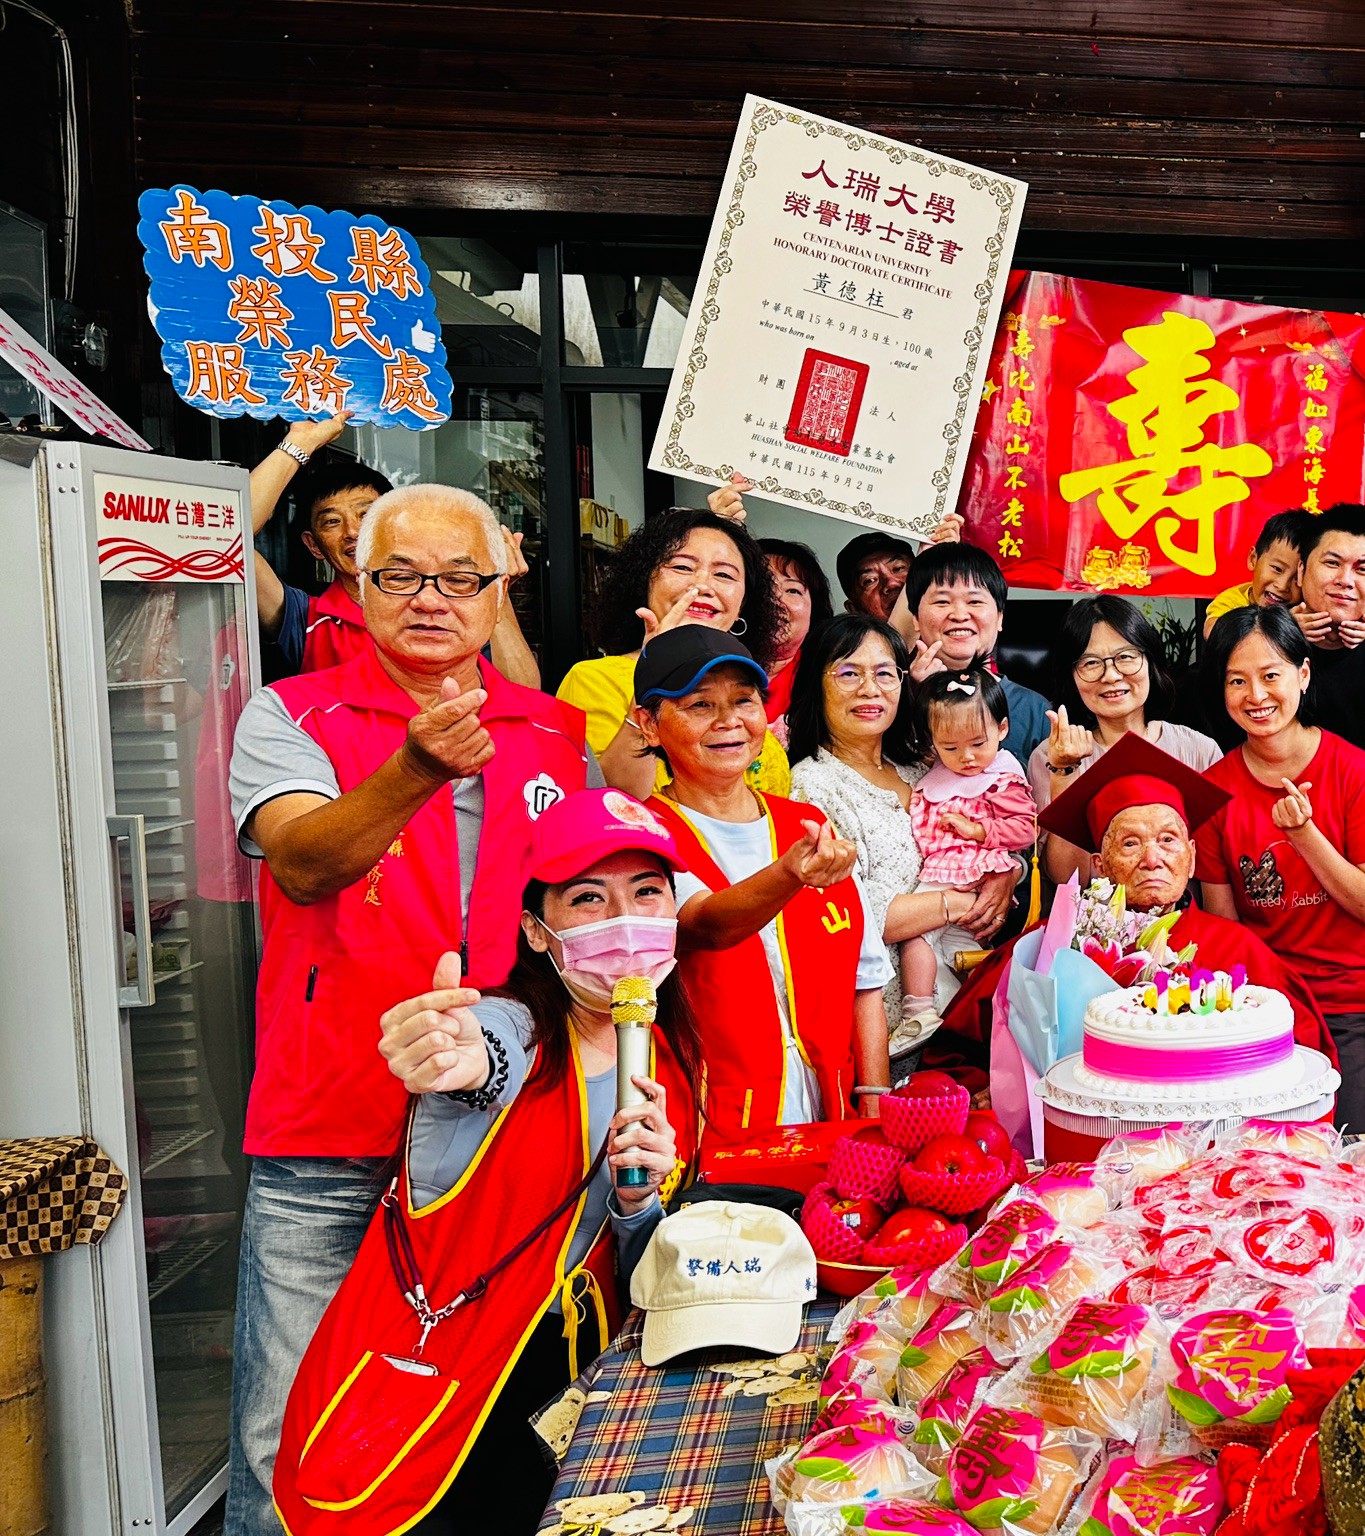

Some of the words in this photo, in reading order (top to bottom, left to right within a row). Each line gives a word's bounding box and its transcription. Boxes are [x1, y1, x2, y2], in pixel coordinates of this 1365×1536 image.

[801, 160, 956, 224] 人瑞大學
[161, 192, 424, 298] 南投縣
[783, 191, 963, 265] 榮譽博士證書
[773, 237, 829, 261] HONORARY
[831, 253, 890, 280] DOCTORATE
[891, 274, 953, 299] CERTIFICATE
[803, 231, 872, 260] CENTENARIAN
[874, 253, 932, 278] UNIVERSITY
[228, 276, 394, 356] 榮民
[812, 272, 884, 308] 黃德柱
[902, 308, 914, 320] 君
[759, 319, 773, 329] who
[775, 323, 787, 332] was
[789, 327, 804, 338] born
[186, 342, 452, 420] 服務處
[758, 373, 786, 389] 財團
[869, 405, 896, 421] 法人
[751, 433, 782, 448] HUASHAN
[784, 442, 808, 455] SOCIAL
[810, 449, 839, 463] WELFARE
[842, 458, 883, 474] FOUNDATION
[103, 491, 171, 524] SANLUX
[175, 499, 235, 529] 台灣三洋
[364, 859, 384, 906] 務處
[1291, 890, 1329, 908] Rabbit
[686, 1257, 762, 1277] 警備人瑞
